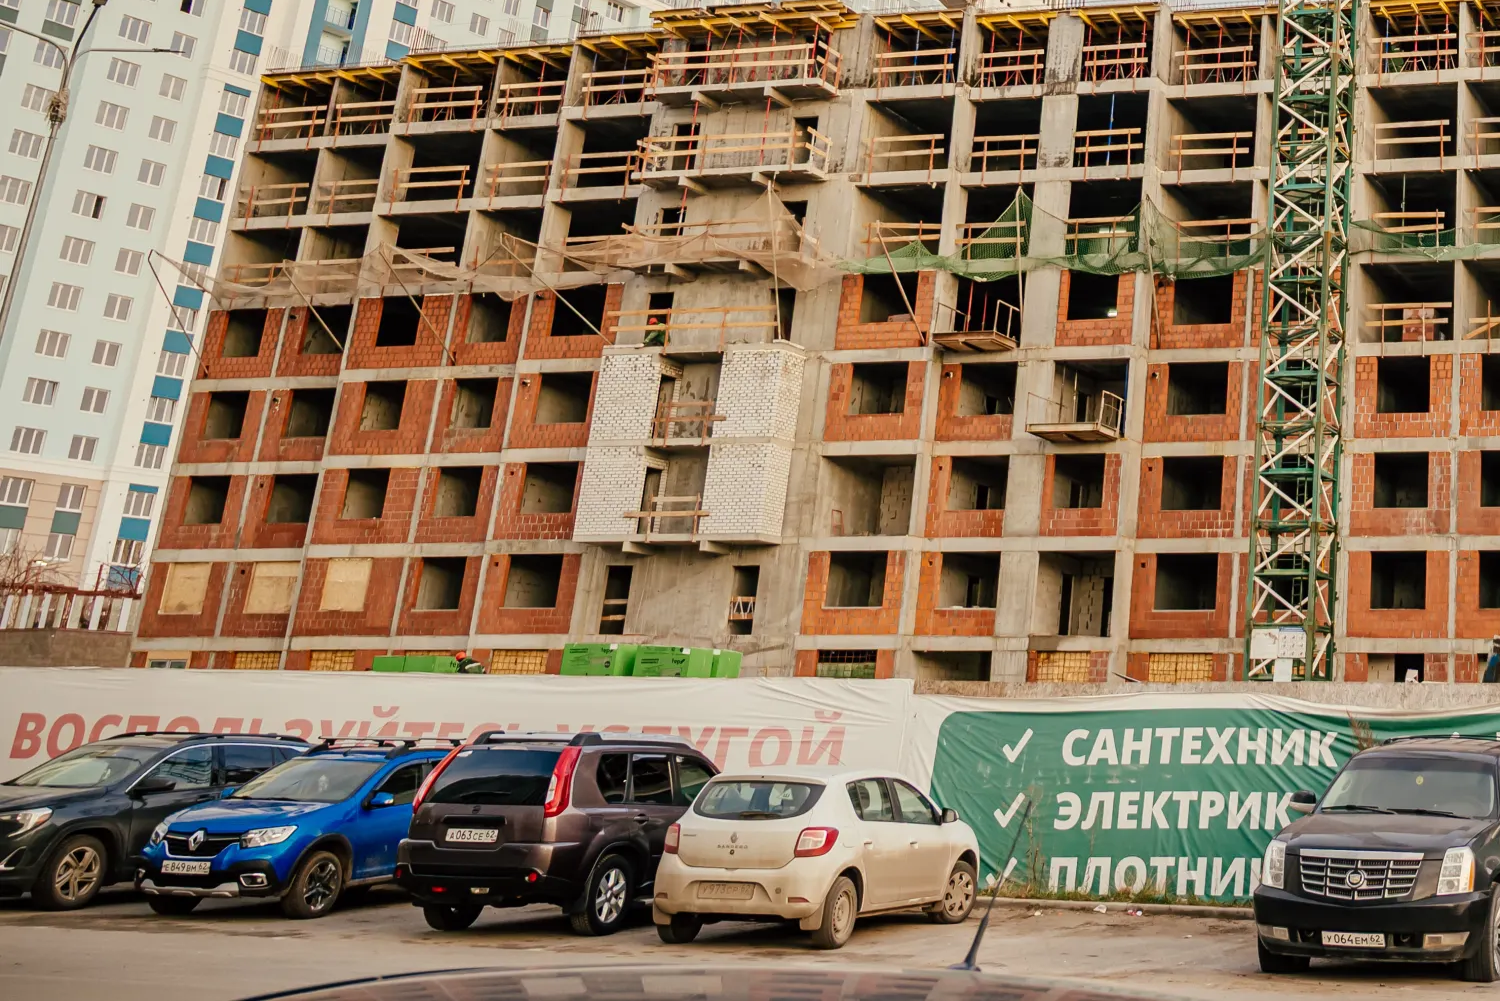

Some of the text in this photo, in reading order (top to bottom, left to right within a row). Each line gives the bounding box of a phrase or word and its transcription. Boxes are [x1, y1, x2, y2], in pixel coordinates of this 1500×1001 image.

[1061, 727, 1339, 767] САНТЕХНИК
[1053, 791, 1294, 830] ЭЛЕКТРИК
[1369, 934, 1381, 943] 62
